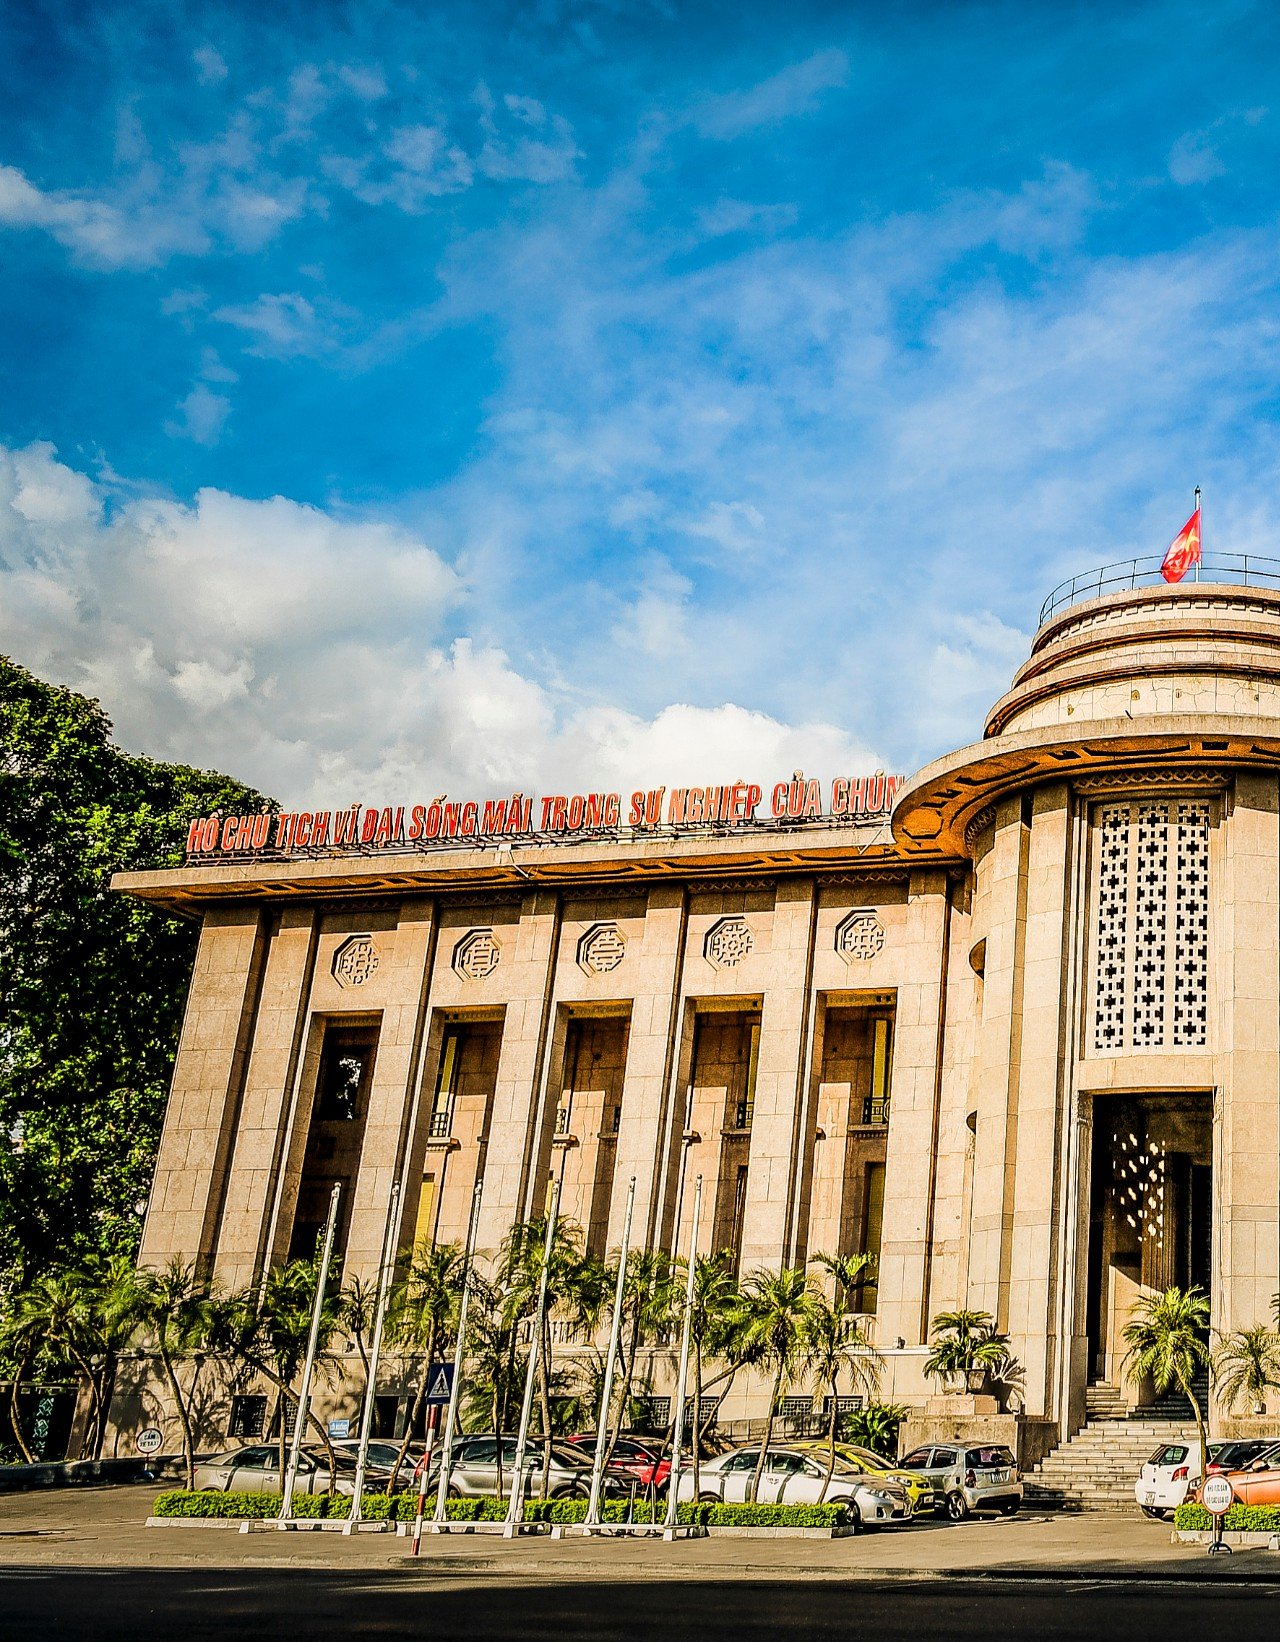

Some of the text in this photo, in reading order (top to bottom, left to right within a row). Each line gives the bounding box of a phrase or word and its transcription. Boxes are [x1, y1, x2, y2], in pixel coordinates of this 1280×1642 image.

[186, 809, 223, 852] HỒ
[221, 805, 271, 850] CHỦ
[275, 811, 329, 855] TỊCH
[332, 803, 363, 845] VĨ
[361, 807, 405, 847] ĐẠI
[408, 794, 477, 839] SỐNG
[480, 792, 532, 835] MÃI
[540, 793, 621, 831] TRONG
[629, 786, 665, 831] SỰ
[667, 779, 762, 827] NGHIỆP
[770, 769, 822, 818] CỦA
